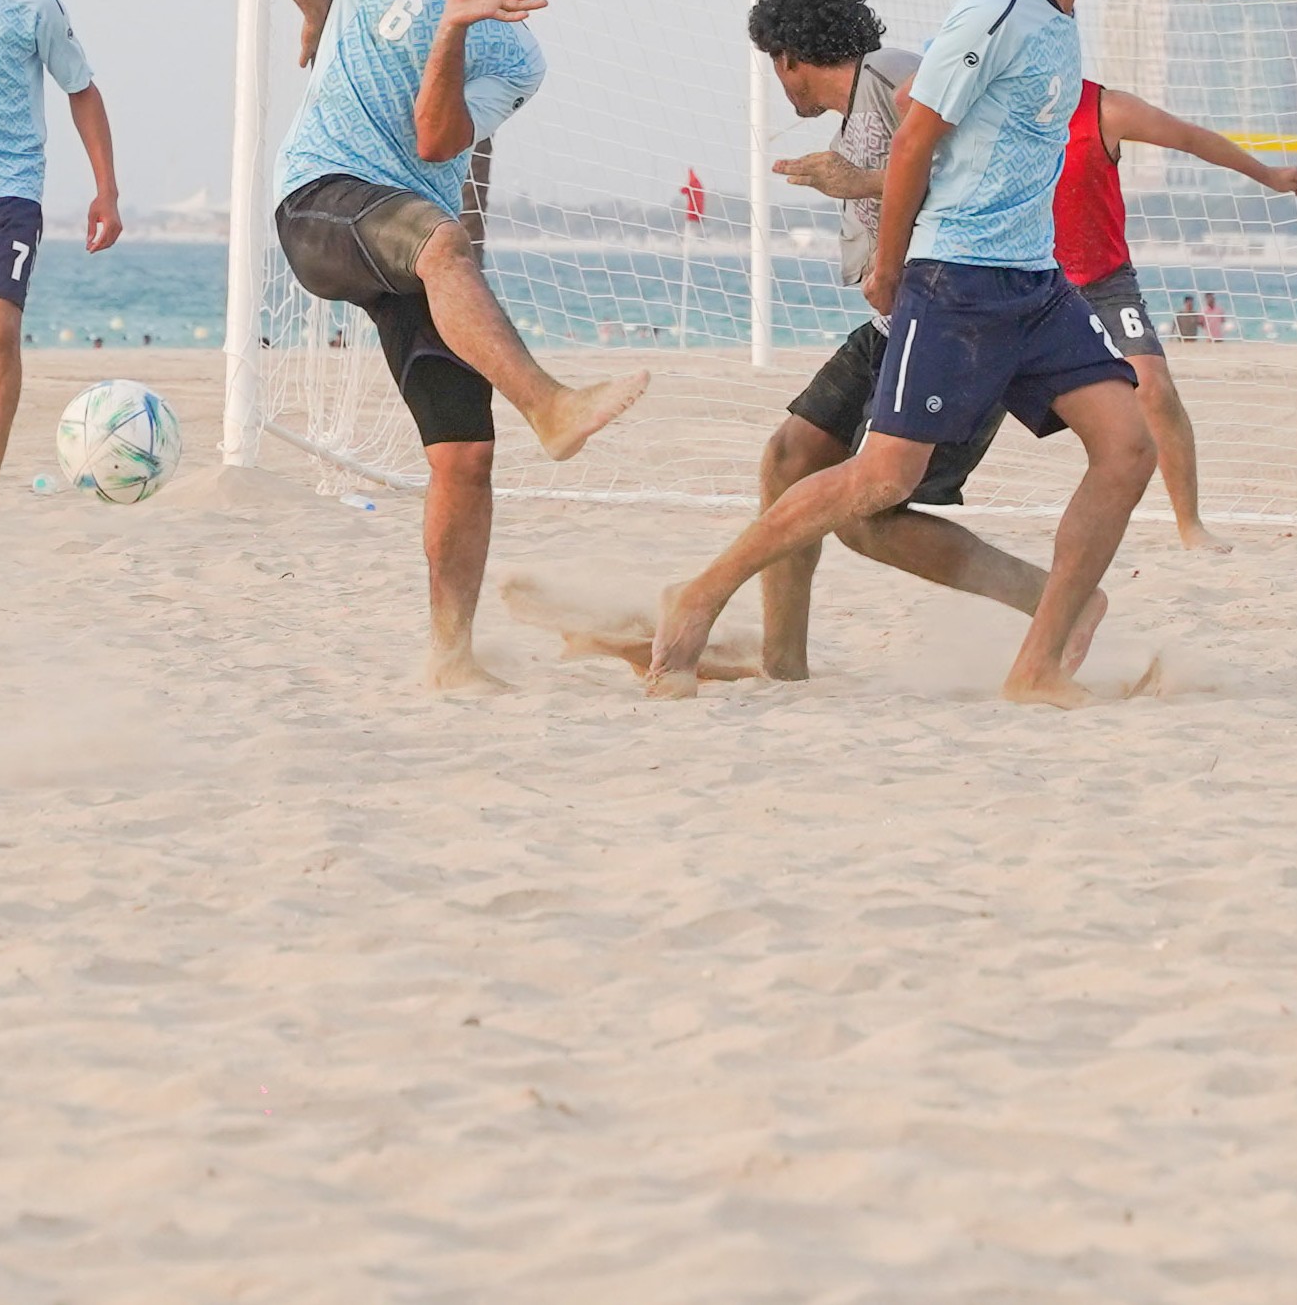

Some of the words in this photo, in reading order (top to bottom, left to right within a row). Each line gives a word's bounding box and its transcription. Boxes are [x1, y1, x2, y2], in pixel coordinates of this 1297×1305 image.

[1035, 76, 1062, 123] 2
[12, 241, 30, 281] 7
[1089, 314, 1124, 359] 2
[1120, 307, 1144, 339] 6
